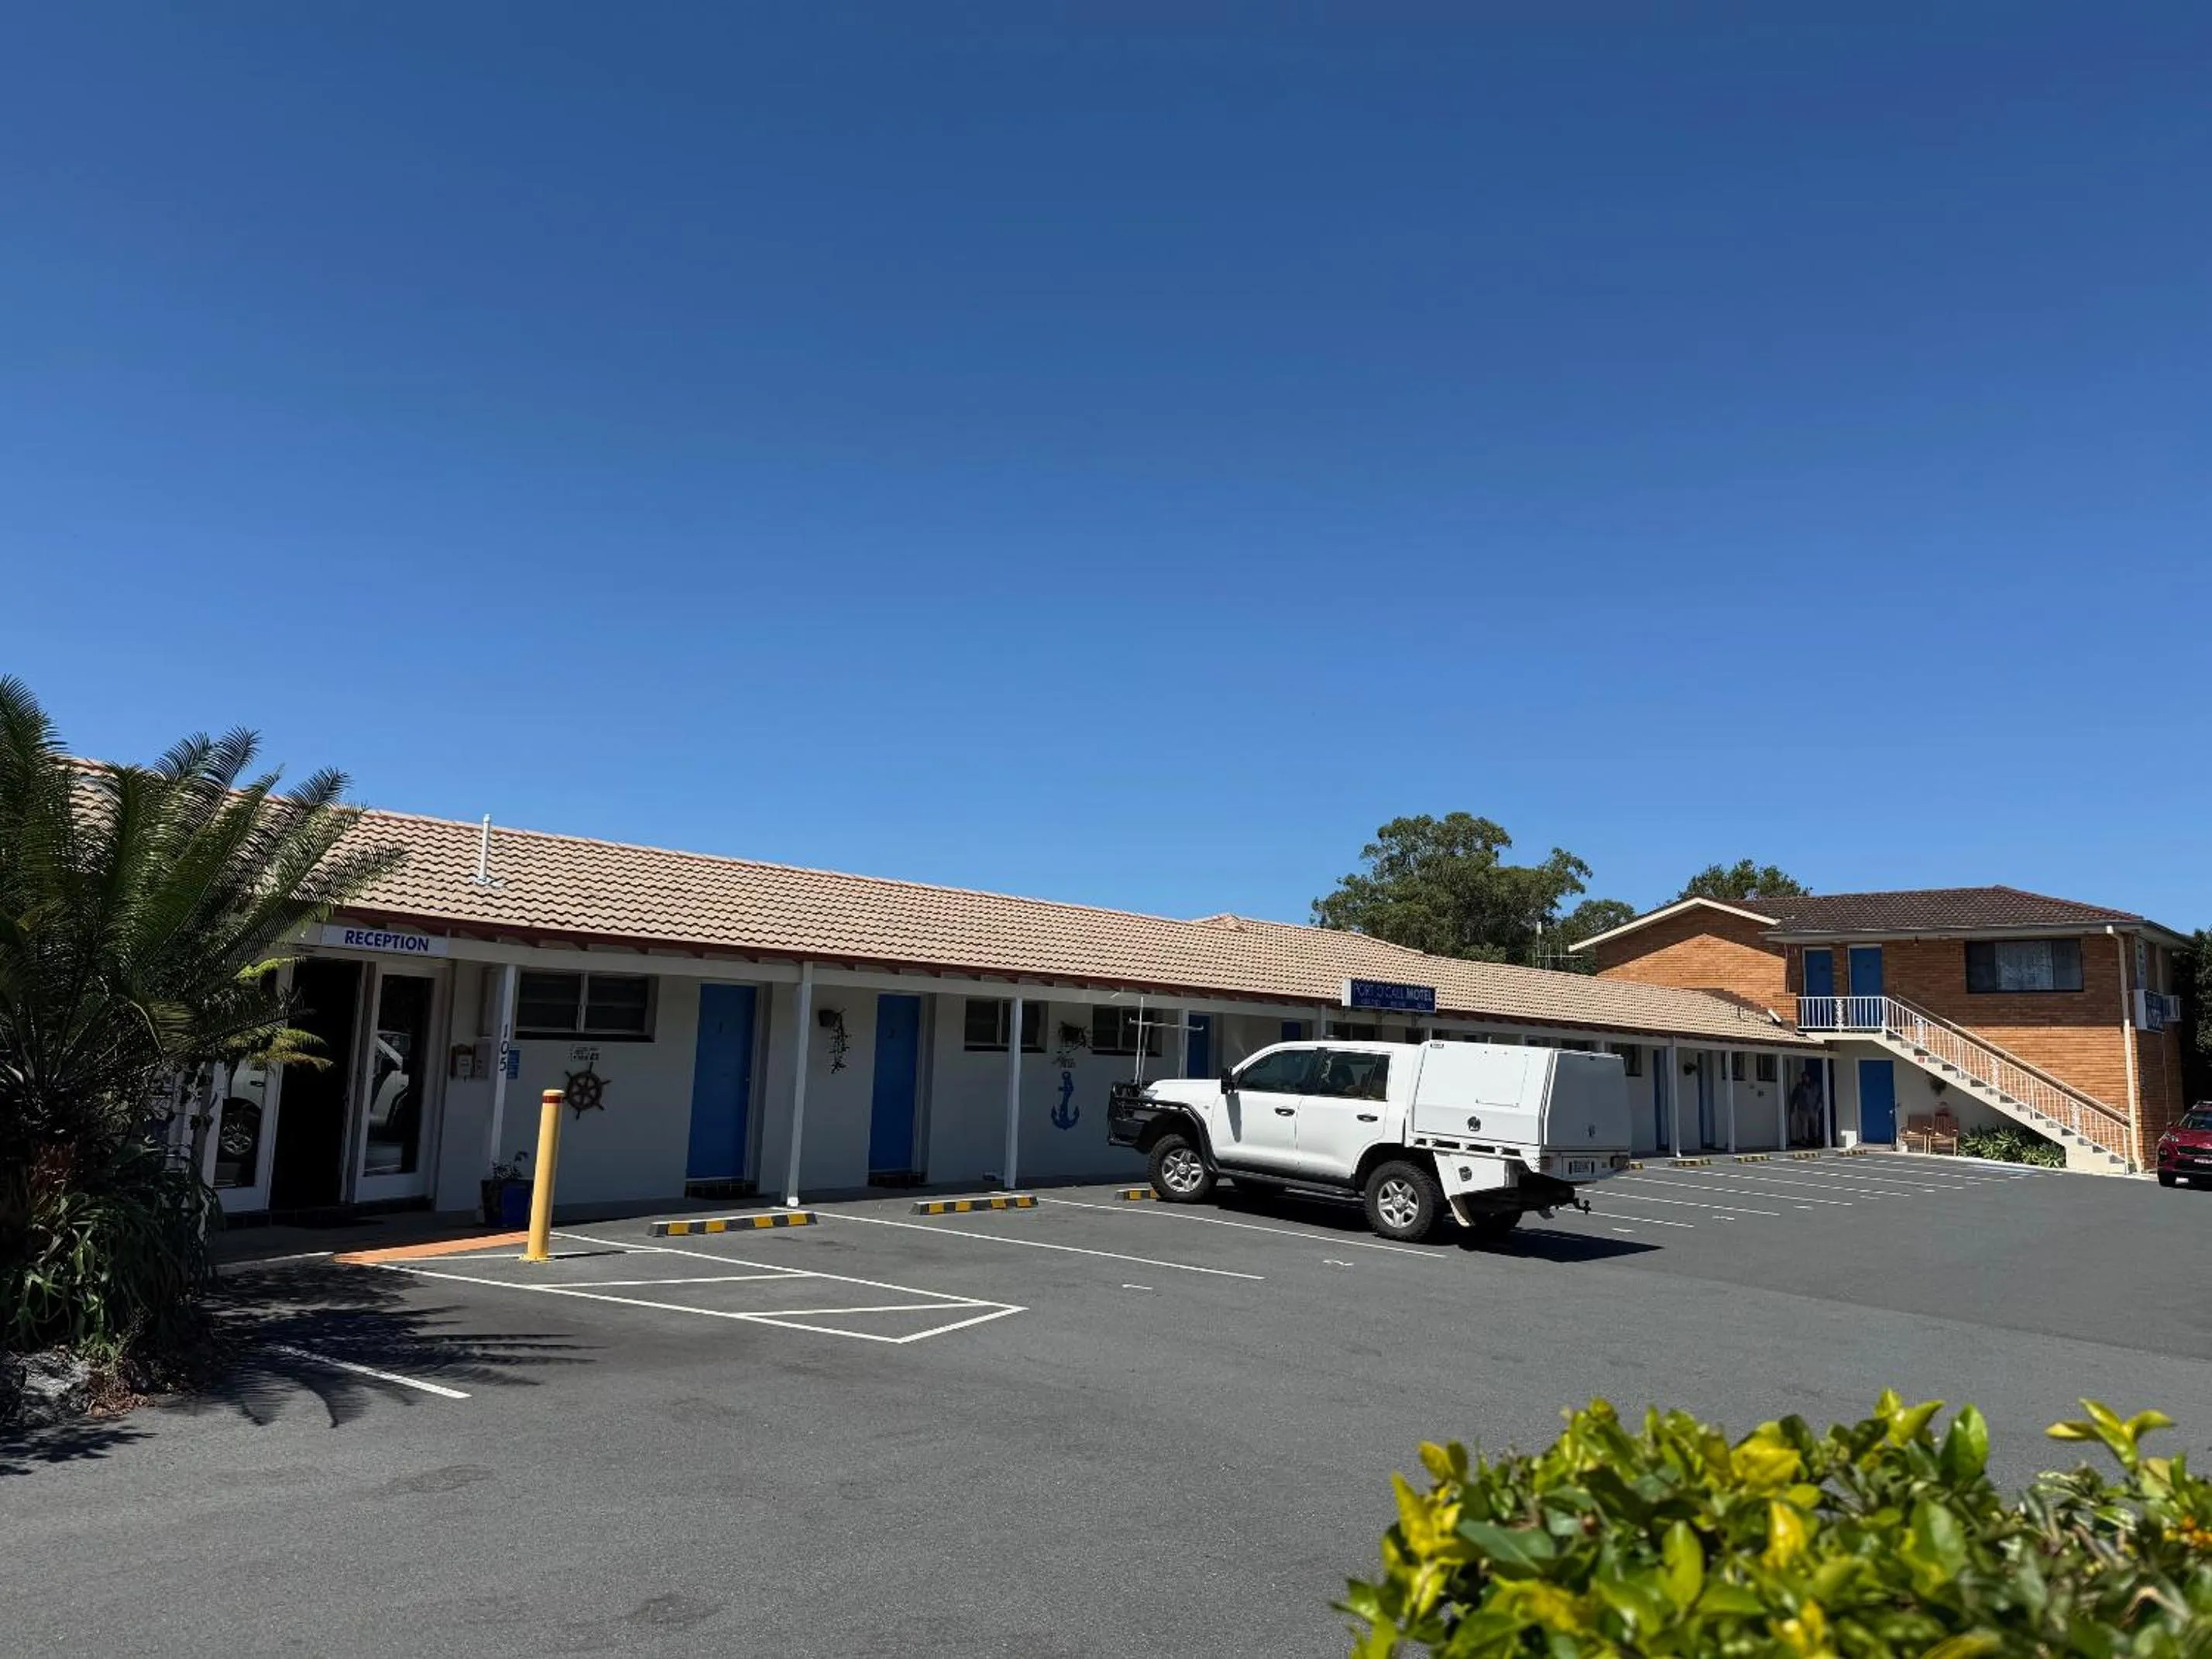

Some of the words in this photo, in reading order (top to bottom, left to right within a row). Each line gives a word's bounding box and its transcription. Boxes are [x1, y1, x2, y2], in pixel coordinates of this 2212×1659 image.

[345, 930, 429, 951] RECEPTION
[1406, 987, 1434, 1001] MOTEL
[499, 1024, 509, 1072] 105
